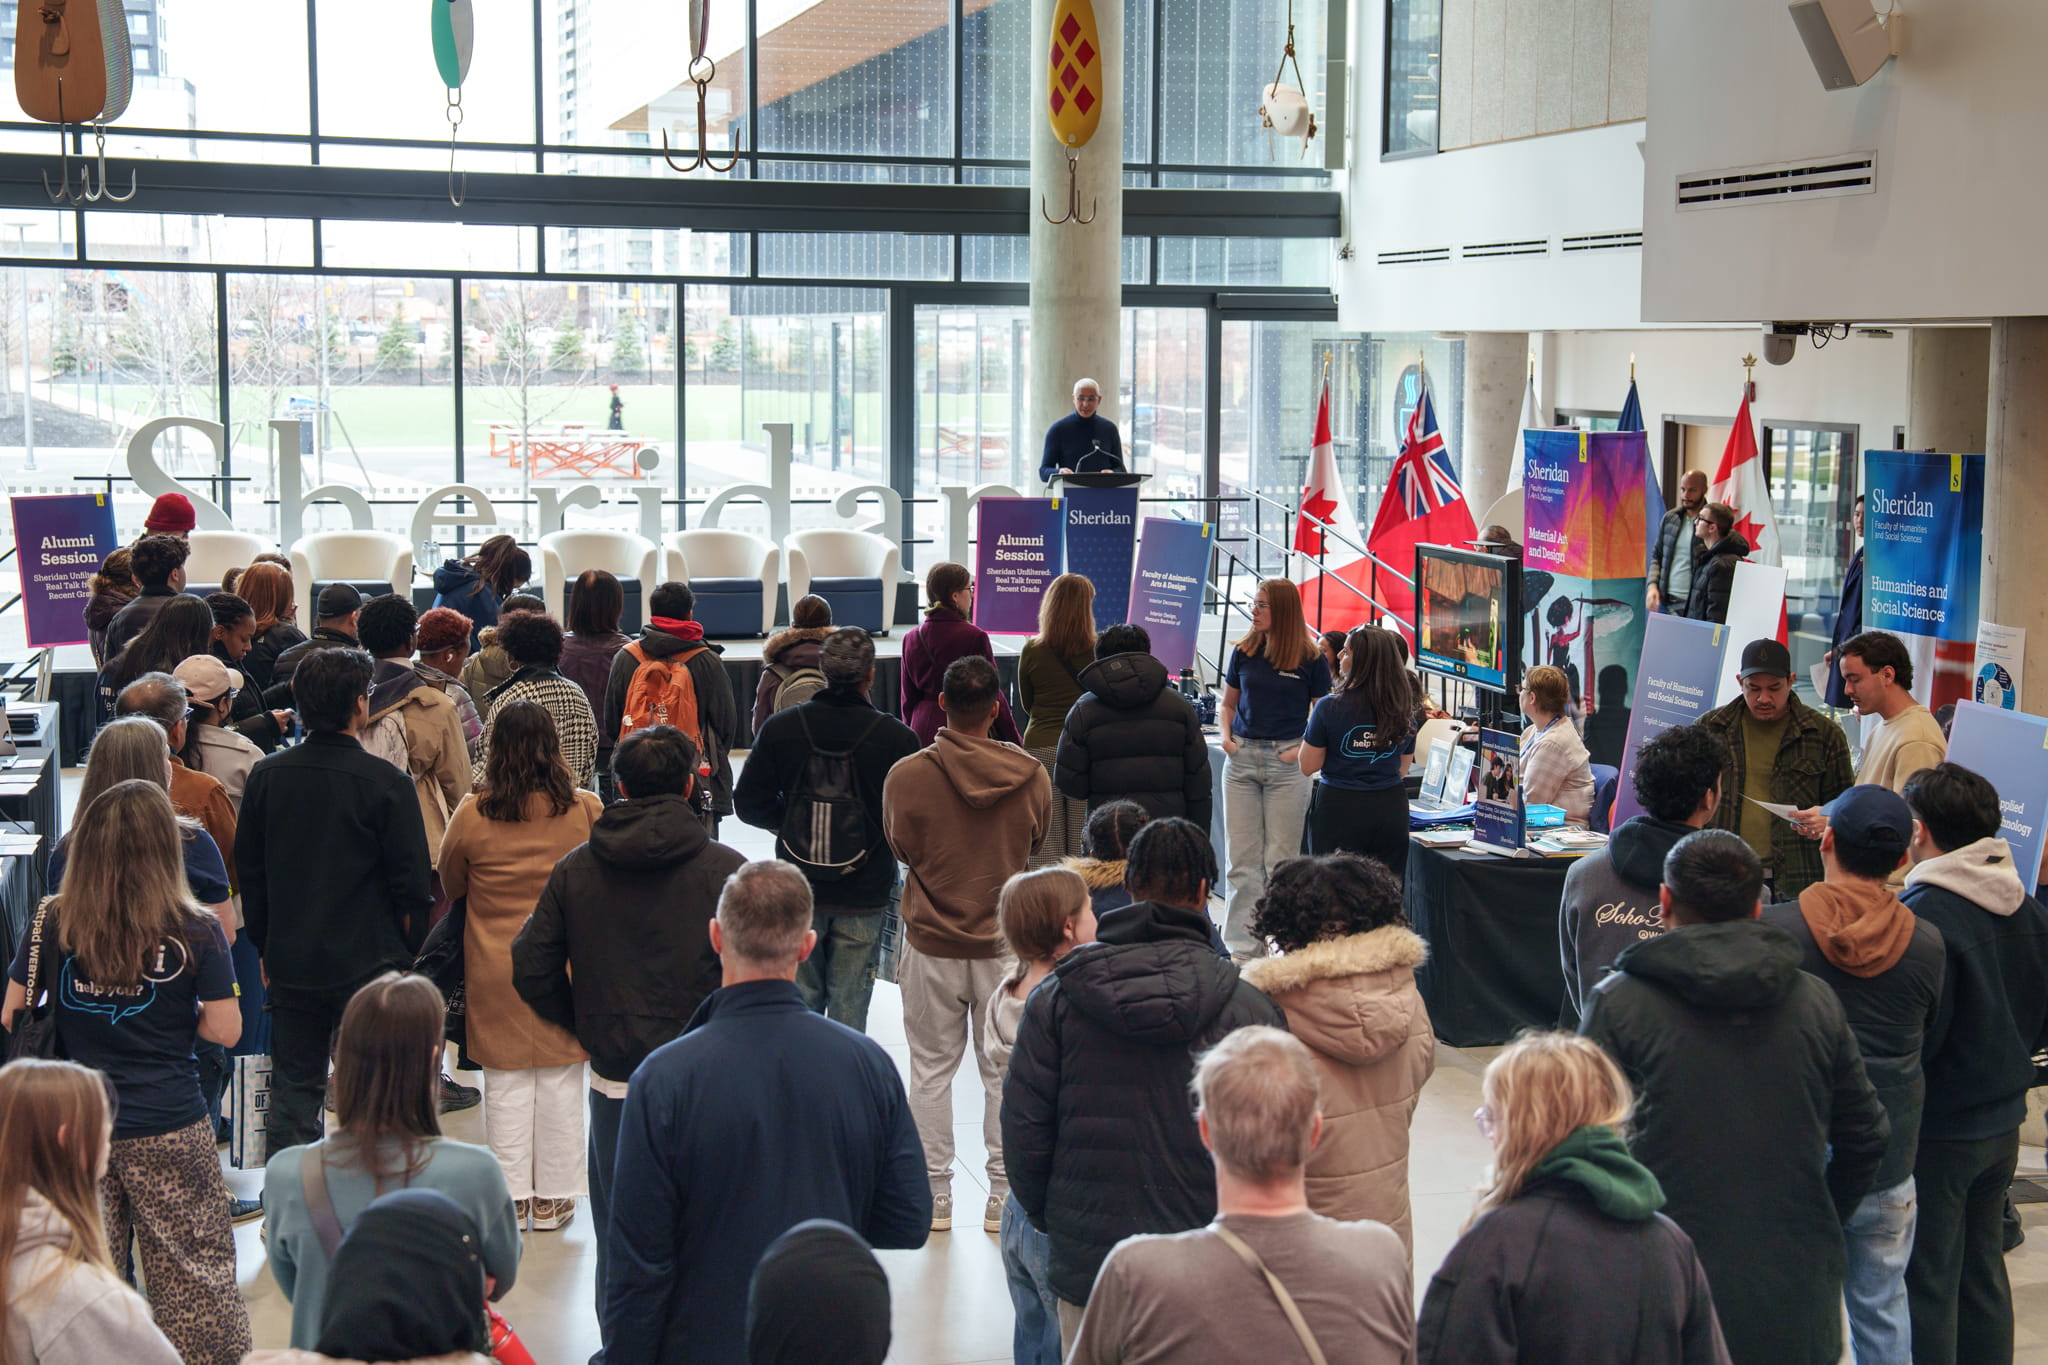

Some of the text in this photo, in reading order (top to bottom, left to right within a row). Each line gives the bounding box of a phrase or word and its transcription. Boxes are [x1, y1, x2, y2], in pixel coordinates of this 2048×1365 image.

[1528, 459, 1569, 482] Sheridan
[126, 416, 1023, 585] Sheridan
[1872, 488, 1934, 518] Sheridan
[1069, 510, 1130, 525] Sheridan
[1528, 527, 1556, 542] Material
[1874, 520, 1928, 534] Faculty of Humanities
[40, 534, 96, 550] Alumni
[997, 534, 1044, 546] Alumni
[1874, 532, 1922, 544] and Social Sciences
[41, 551, 98, 566] Session
[995, 550, 1044, 562] Session
[1528, 546, 1566, 564] and Design
[34, 572, 68, 582] Sheridan
[1142, 570, 1161, 580] Faculty
[1168, 573, 1198, 584] Animation,
[46, 582, 62, 590] Real
[63, 581, 80, 590] Talk
[1150, 580, 1162, 588] Arts
[1168, 582, 1186, 592] Design
[1872, 576, 1948, 600] Humanities and
[48, 592, 76, 600] Recent
[1872, 598, 1946, 623] Social Sciences
[1648, 676, 1704, 696] Faculty of Humanities
[1648, 691, 1698, 709] and Social Sciences
[1353, 740, 1372, 748] help
[2000, 800, 2024, 814] pplied
[2001, 816, 2032, 838] hnology
[1596, 901, 1646, 928] Soho
[26, 895, 49, 1006] Wattpad WEBTOON
[74, 979, 144, 997] help you?
